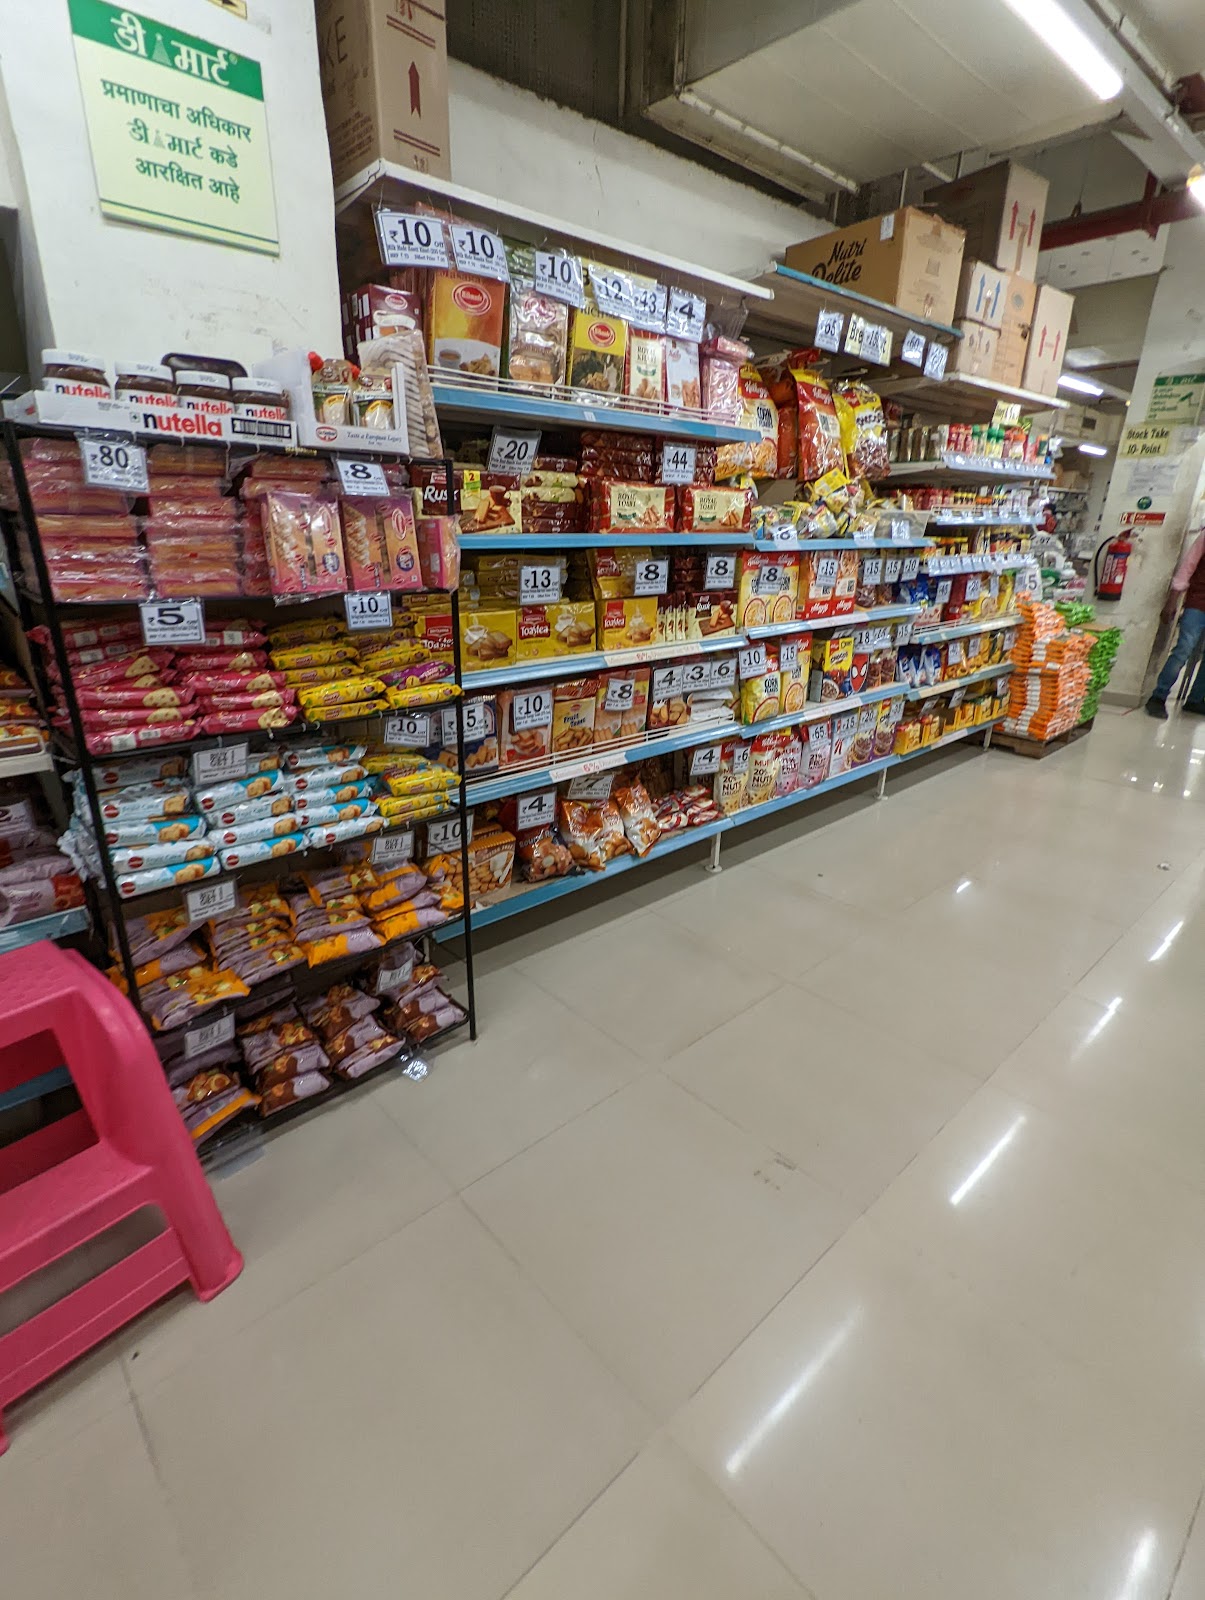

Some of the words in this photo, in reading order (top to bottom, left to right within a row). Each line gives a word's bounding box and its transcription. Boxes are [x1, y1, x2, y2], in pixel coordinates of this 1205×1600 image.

[111, 12, 148, 57] डी
[171, 40, 230, 86] मार्ट
[100, 78, 180, 119] प्रमाणाचा
[186, 106, 251, 143] अधिकार
[126, 118, 149, 144] डी
[165, 134, 203, 159] मार्ट
[209, 145, 238, 168] कडे
[136, 158, 203, 190] आरक्षित
[209, 177, 240, 204] आहे
[828, 238, 867, 266] Nutri
[143, 411, 223, 437] nutella
[1127, 428, 1149, 439] Stock
[1151, 427, 1170, 438] Take
[1140, 444, 1161, 455] Point
[563, 713, 579, 723] Fruit
